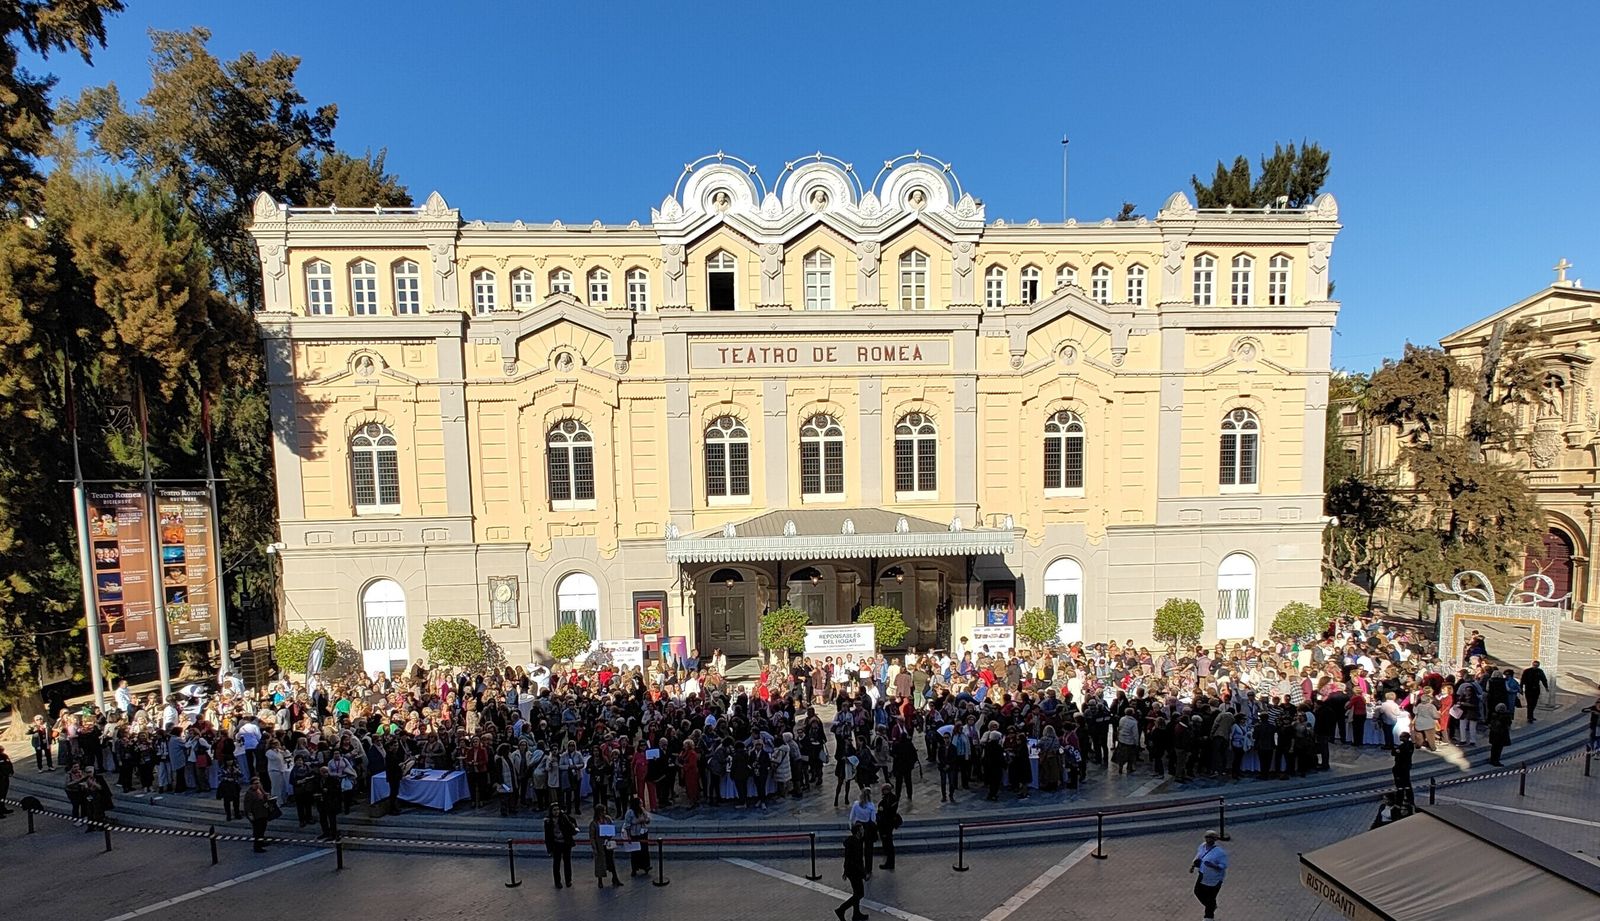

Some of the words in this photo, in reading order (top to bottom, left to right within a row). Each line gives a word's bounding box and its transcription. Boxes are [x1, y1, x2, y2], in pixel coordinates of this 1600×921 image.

[718, 347, 798, 364] TEATRO
[813, 346, 837, 362] DE
[858, 344, 922, 362] ROMEA
[1306, 872, 1356, 918] RISTORANTI
